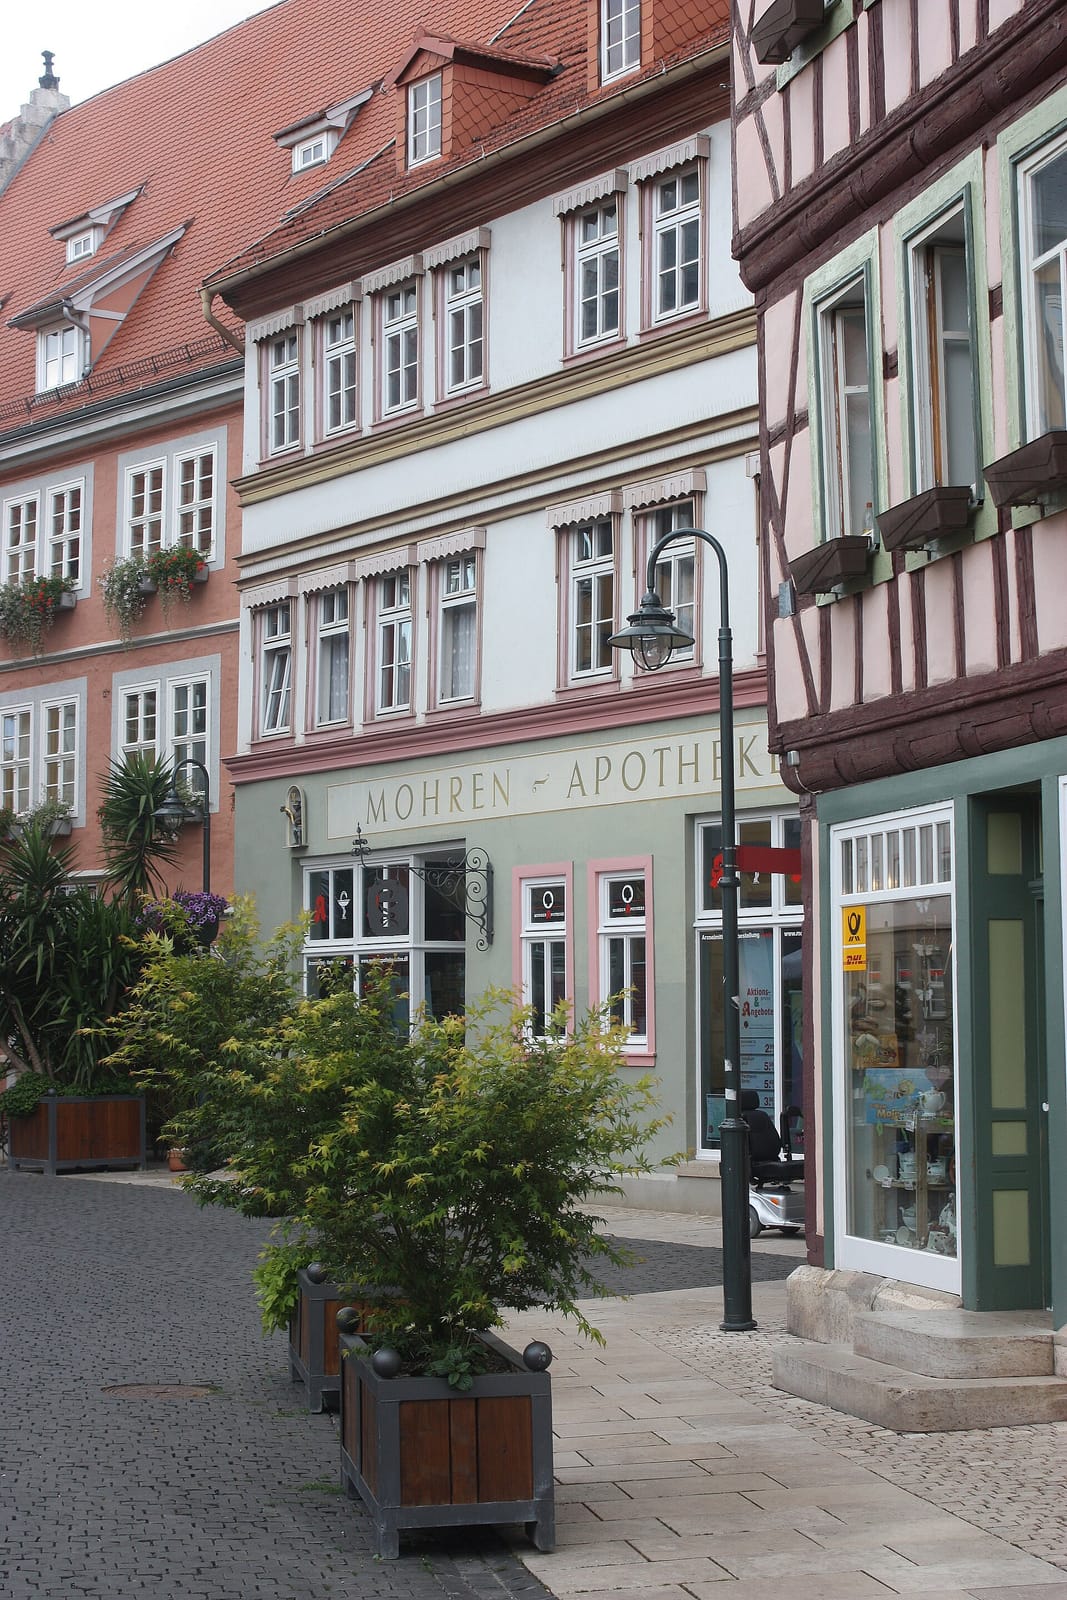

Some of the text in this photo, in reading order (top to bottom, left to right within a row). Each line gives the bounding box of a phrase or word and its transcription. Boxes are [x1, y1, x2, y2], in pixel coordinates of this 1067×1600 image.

[366, 769, 511, 825] MOHREN
[846, 954, 863, 966] DHL
[747, 988, 771, 996] Aktions-
